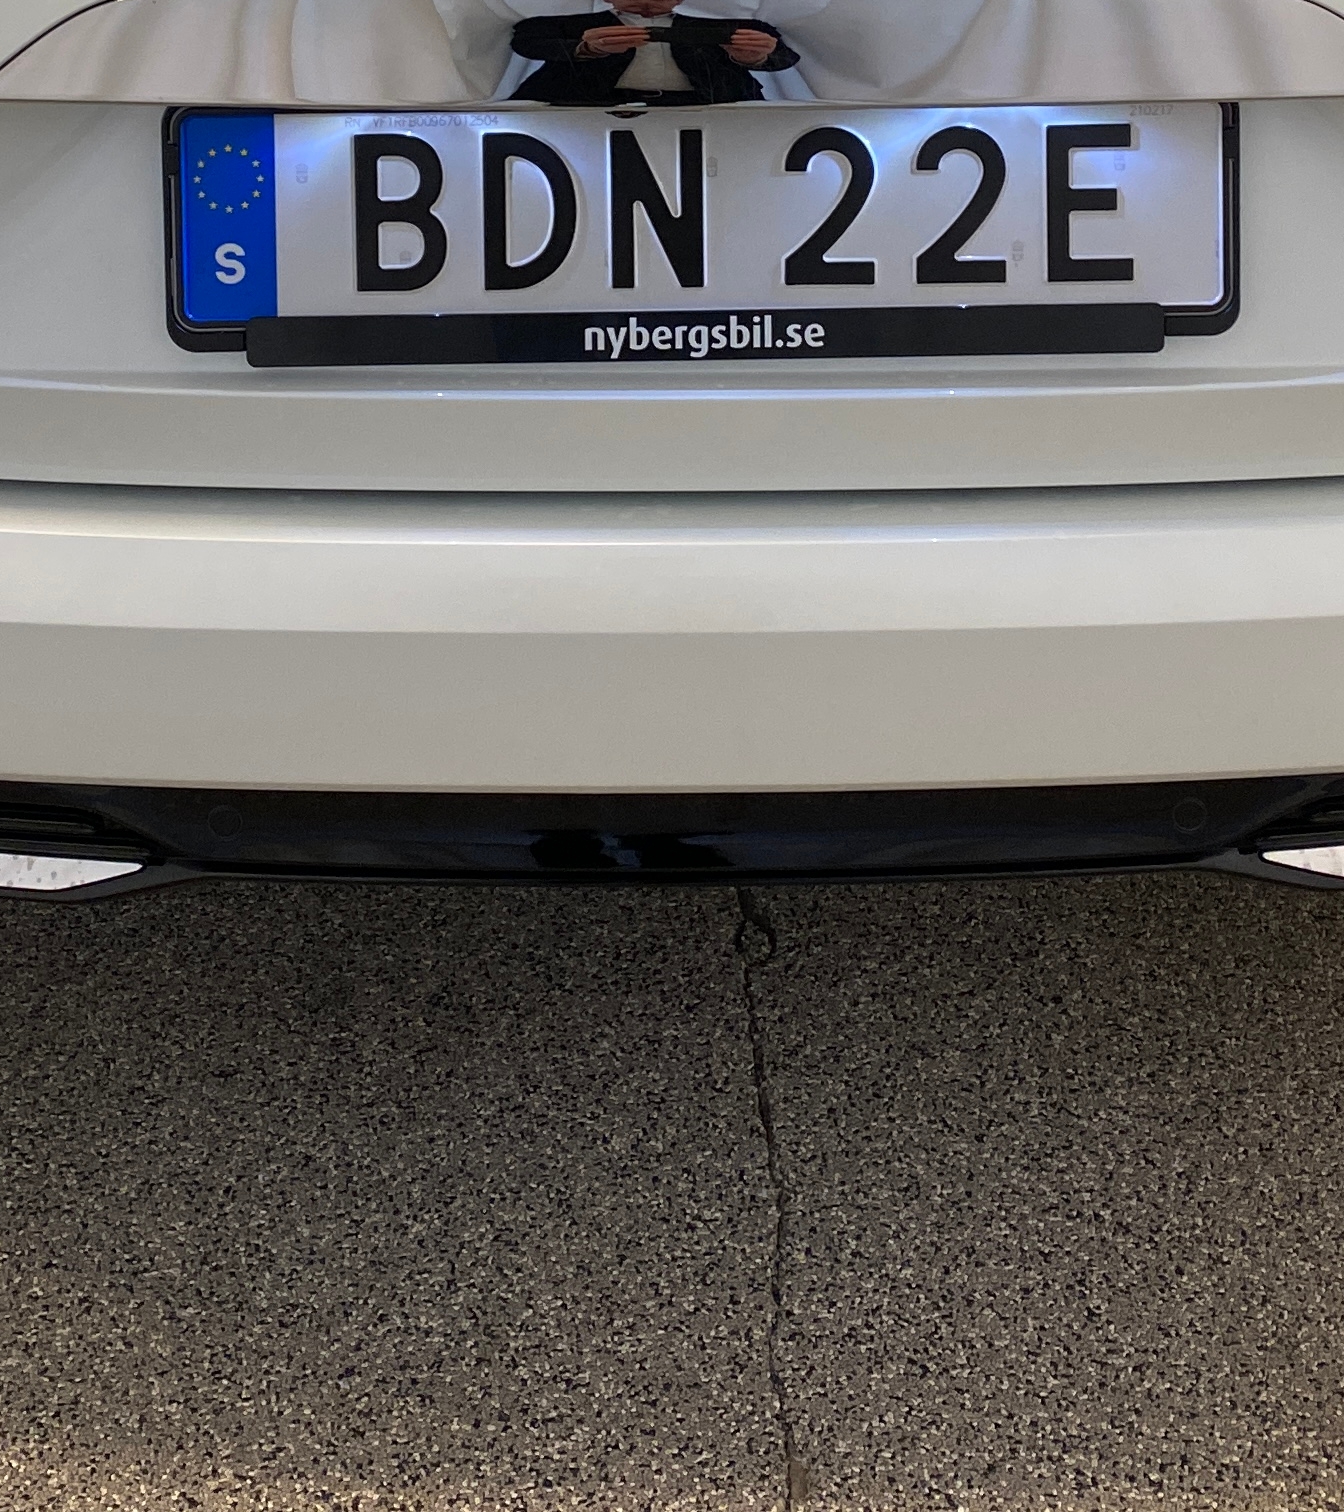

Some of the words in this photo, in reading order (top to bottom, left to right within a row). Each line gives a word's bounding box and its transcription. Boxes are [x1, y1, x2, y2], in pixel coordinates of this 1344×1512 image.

[353, 129, 705, 292] BDN
[782, 123, 1135, 285] 22E
[214, 242, 246, 285] S
[584, 314, 825, 359] nybergsbil.se
